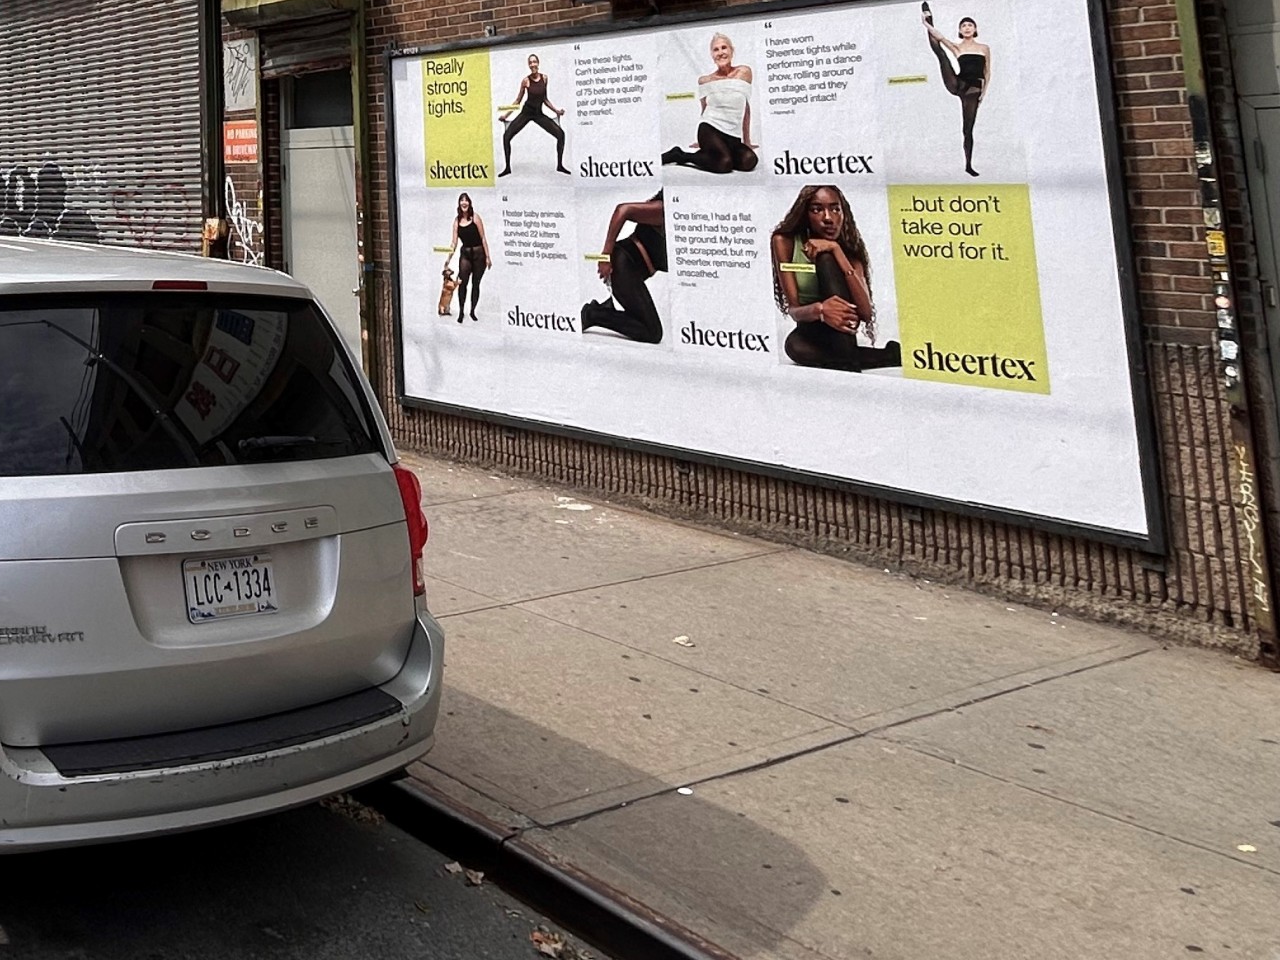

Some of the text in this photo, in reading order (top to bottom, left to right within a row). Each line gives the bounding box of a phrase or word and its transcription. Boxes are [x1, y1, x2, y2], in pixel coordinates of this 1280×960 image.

[770, 38, 790, 46] have
[792, 35, 814, 44] worn
[766, 41, 856, 58] Sheertex tights while
[426, 58, 465, 76] Really
[767, 58, 814, 71] performing
[816, 57, 824, 65] in
[833, 55, 863, 64] dance
[793, 69, 820, 80] rolling
[822, 66, 854, 77] around
[427, 80, 468, 96] strong
[769, 85, 780, 93] on
[809, 81, 826, 90] and
[828, 80, 848, 90] they
[769, 92, 837, 105] emerged intact!
[428, 99, 466, 118] tights.
[429, 160, 488, 180] sheertex
[580, 156, 654, 178] sheertex
[774, 150, 874, 175] sheertex
[949, 195, 1001, 213] don't
[673, 212, 690, 220] One
[715, 213, 731, 221] had
[739, 212, 752, 221] flat
[674, 224, 687, 232] tire
[688, 224, 702, 232] and
[704, 224, 719, 232] had
[721, 225, 729, 233] to
[730, 225, 744, 235] get
[901, 218, 983, 236] take our
[720, 236, 732, 246] My
[733, 237, 754, 245] knee
[675, 247, 688, 255] got
[730, 248, 744, 256] but
[745, 249, 759, 259] my
[903, 241, 1009, 261] word for it.
[676, 257, 751, 269] Sheertex remained
[677, 270, 719, 279] unscathed.
[507, 305, 577, 332] sheertex
[681, 321, 770, 353] sheertex
[912, 342, 1037, 381] sheertex
[145, 517, 319, 543] DODGE
[208, 558, 253, 572] NEW YORK
[193, 567, 272, 605] LCC 1334
